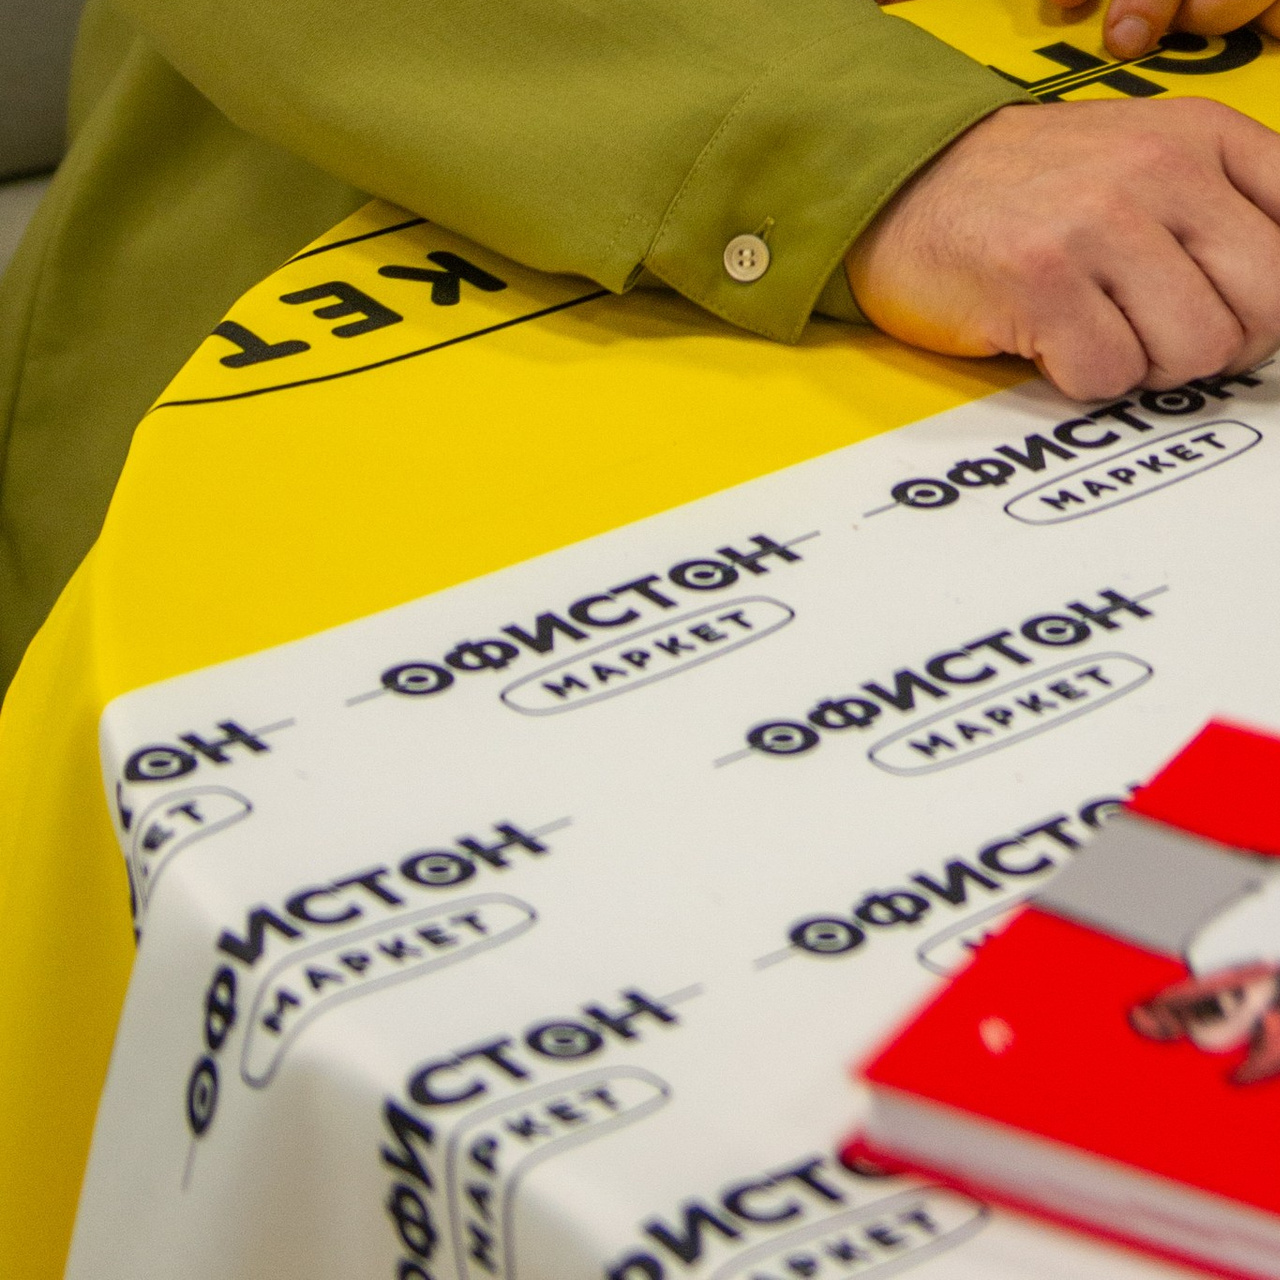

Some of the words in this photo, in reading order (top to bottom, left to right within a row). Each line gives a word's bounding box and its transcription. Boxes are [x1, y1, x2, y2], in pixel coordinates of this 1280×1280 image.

[1038, 430, 1230, 513] МАРКЕТ
[379, 533, 804, 698] ОФИСТОН
[541, 607, 758, 701] МАРКЕТ
[745, 588, 1154, 757] ОФИСТОН
[909, 663, 1116, 761] МАРКЕТ
[186, 820, 551, 1137] ОФИСТОН
[260, 910, 493, 1036] МАРКЕТ
[469, 1083, 621, 1272] МАРКЕТ
[783, 1202, 938, 1280] РКЕТ
